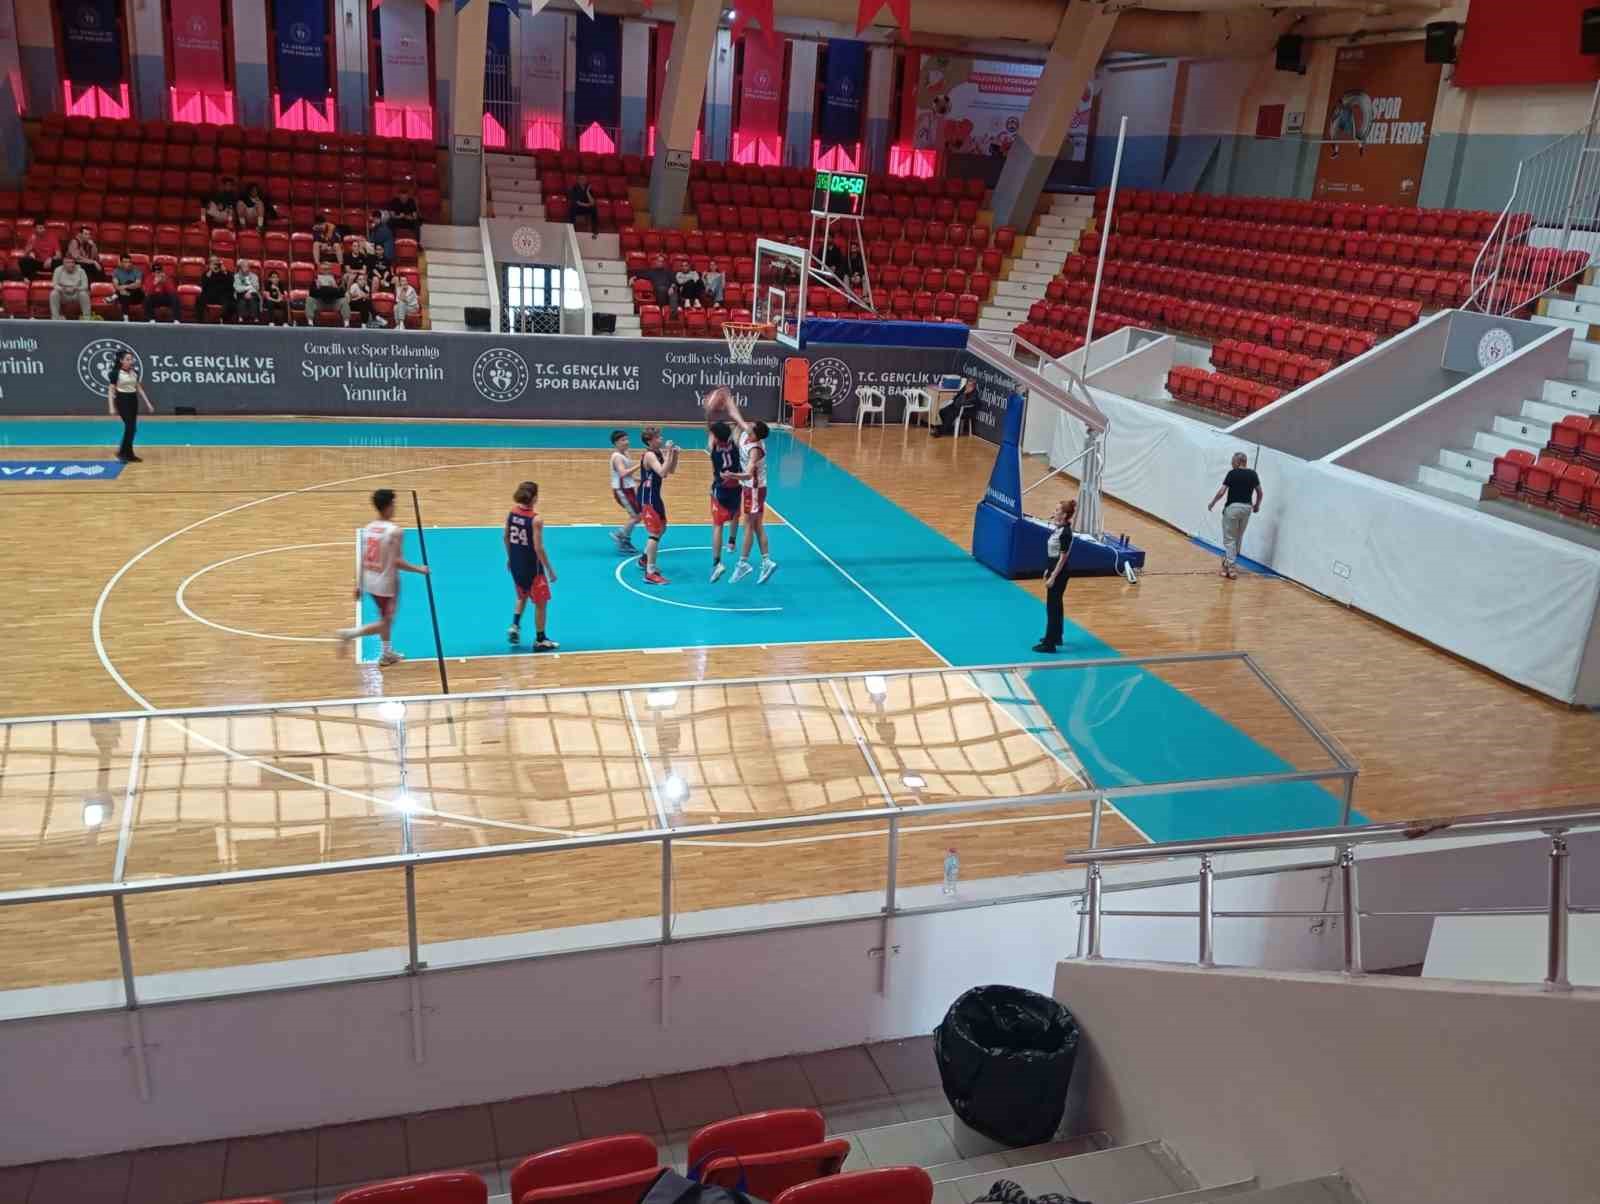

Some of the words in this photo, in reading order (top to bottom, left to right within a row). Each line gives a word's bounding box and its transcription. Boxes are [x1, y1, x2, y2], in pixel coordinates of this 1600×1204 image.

[831, 176, 865, 194] 02:58
[361, 343, 388, 358] Spor
[0, 356, 44, 374] rinin
[149, 355, 178, 367] T.C.
[182, 354, 250, 371] GENÇLİK
[254, 357, 274, 369] VE
[302, 360, 343, 382] Spor
[535, 363, 559, 375] T.C.
[562, 363, 619, 379] GENÇLİK
[622, 366, 640, 377] VE
[151, 370, 192, 383] SPOR
[195, 370, 276, 384] BAKANLIĞI
[535, 378, 569, 390] SPOR
[572, 378, 640, 391] BAKANLIĞI
[661, 369, 697, 389] Spor
[858, 371, 878, 382] T.C.
[880, 371, 929, 386] GENÇLİK
[342, 383, 407, 402] Yanında
[509, 525, 529, 546] 24
